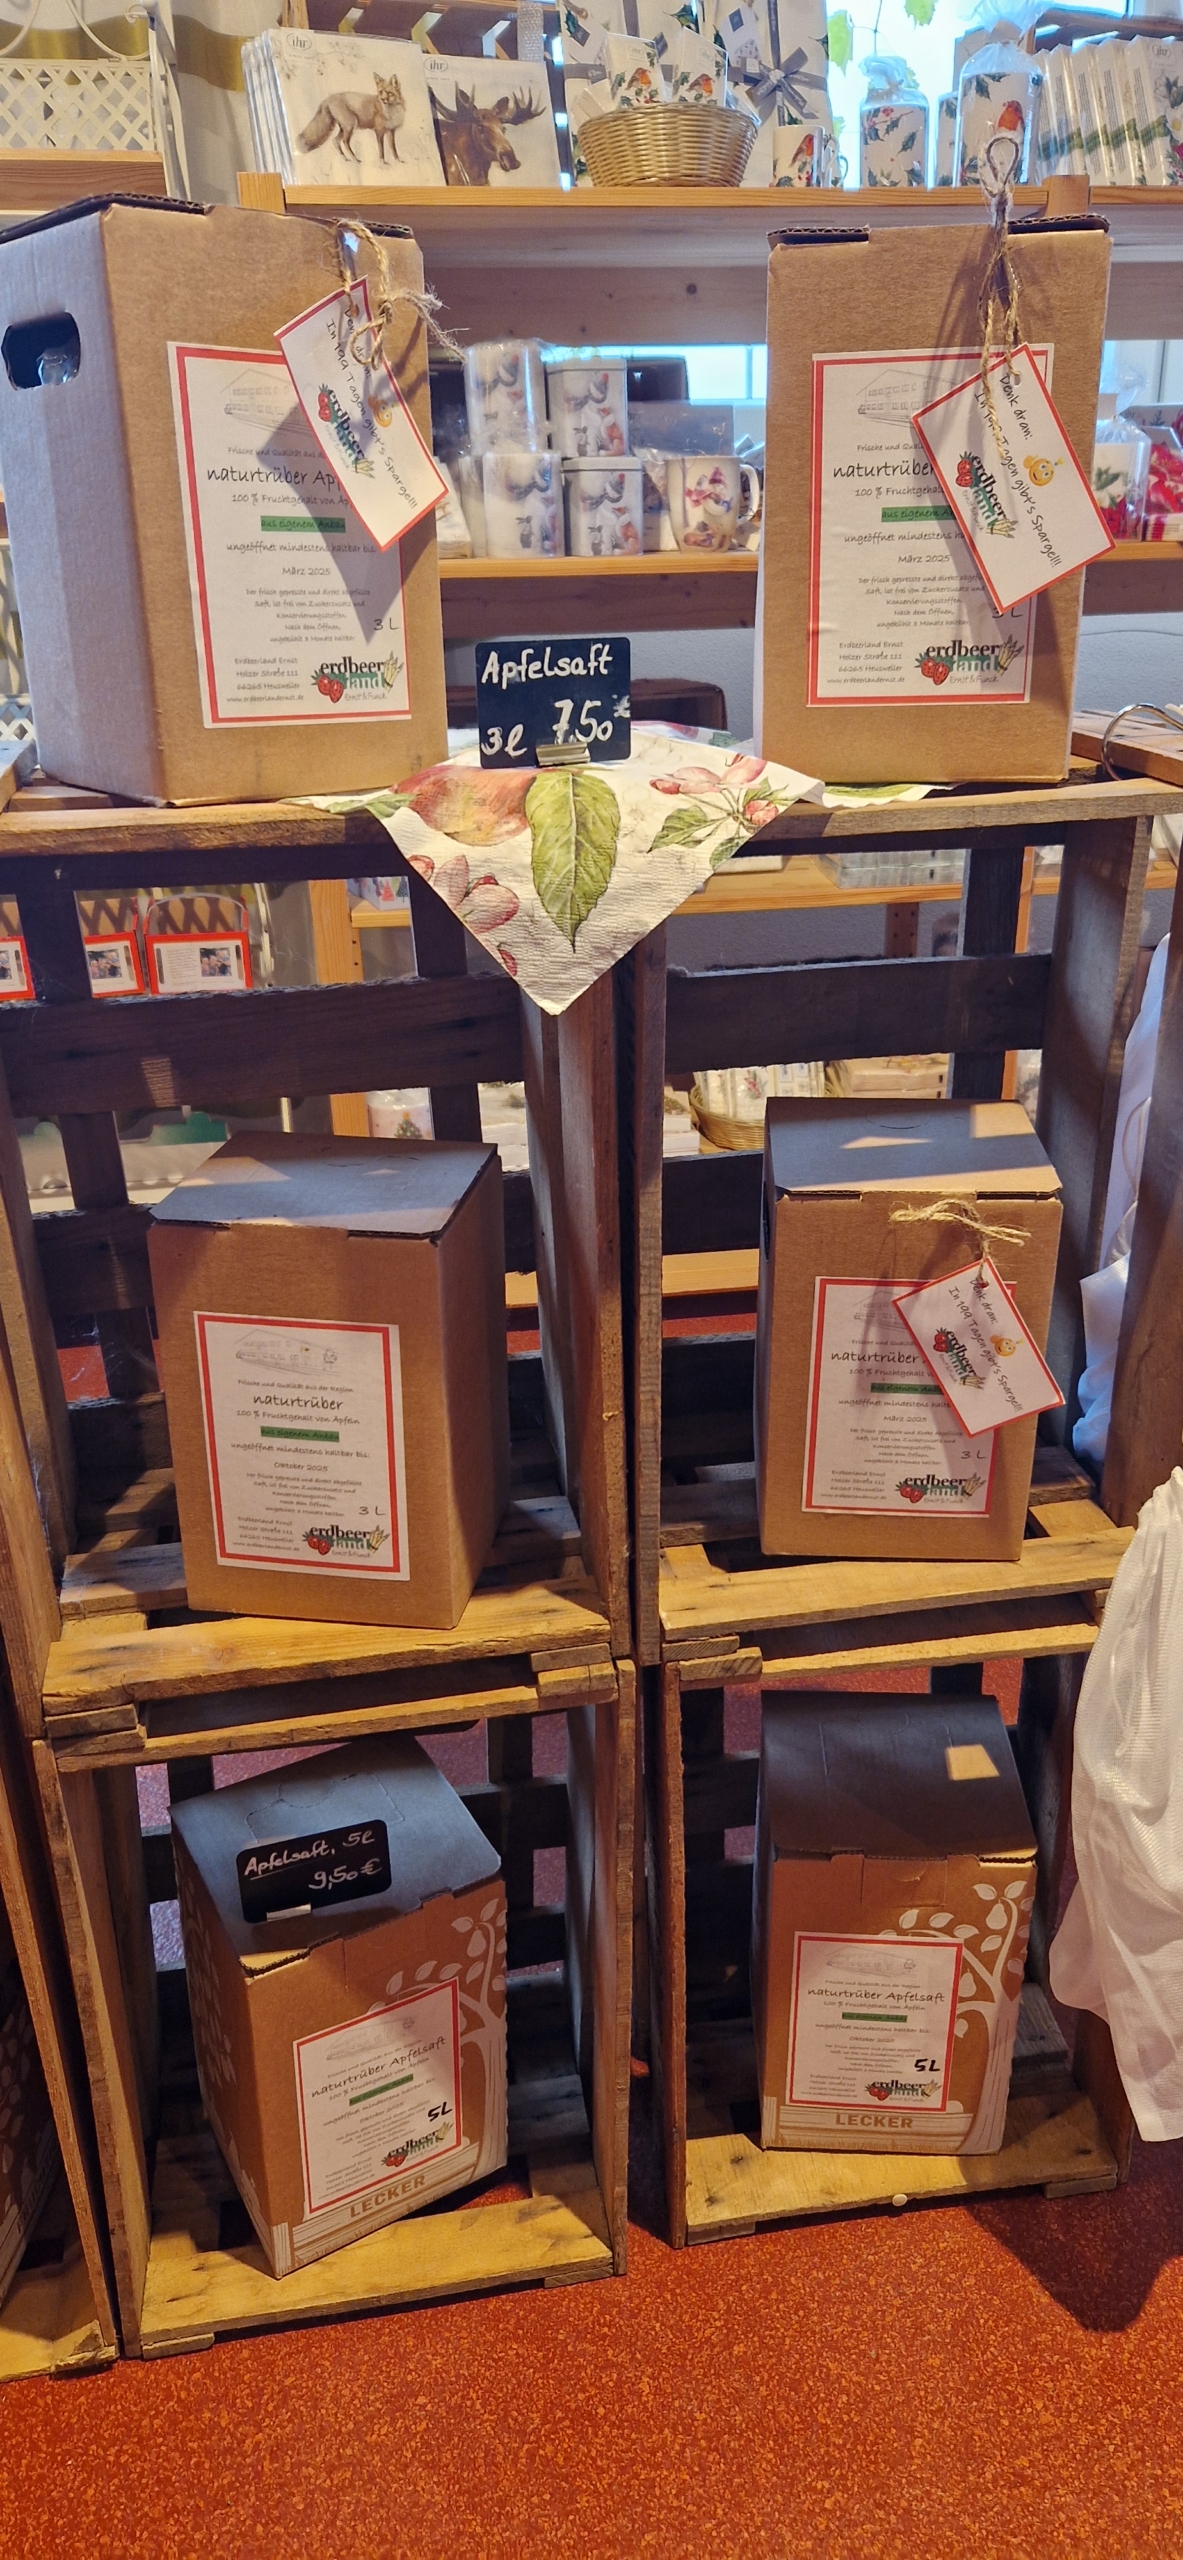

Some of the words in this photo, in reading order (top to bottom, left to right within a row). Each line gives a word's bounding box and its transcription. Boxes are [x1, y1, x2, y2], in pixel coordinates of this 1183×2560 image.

[291, 35, 309, 49] ihr
[429, 60, 445, 71] ihr
[326, 318, 337, 340] In
[999, 373, 1019, 407] Denk
[1013, 409, 1033, 440] dran:
[328, 389, 365, 459] erdbeer
[857, 443, 883, 451] Frische
[974, 388, 988, 409] In
[1011, 479, 1036, 515] gibt's
[207, 465, 308, 484] naturtrüber
[855, 489, 873, 497] 100
[875, 486, 883, 499] %
[973, 455, 1007, 520] erdbeer
[231, 494, 249, 502] 100
[262, 494, 318, 506] Fruchtgehalt
[882, 510, 898, 519] aus
[901, 509, 939, 520] eigenem
[278, 519, 315, 531] eigenem
[844, 532, 896, 545] ungeöffnet
[898, 531, 952, 541] mindestens
[226, 541, 277, 554] ungeöffnet
[279, 542, 329, 552] mindestens
[898, 555, 923, 563] März
[926, 554, 951, 563] 2025
[282, 567, 306, 575] März
[308, 567, 331, 576] 2025
[1011, 607, 1023, 618] L
[373, 619, 384, 631] 3
[389, 617, 399, 630] L
[926, 640, 1000, 658] erdbeer
[320, 656, 384, 675] erdbeer
[481, 643, 613, 690] Apfelsaft
[950, 656, 998, 672] land
[345, 674, 384, 689] land
[969, 1278, 985, 1302] Denk
[981, 1301, 998, 1325] dran:
[948, 1286, 960, 1300] In
[957, 1300, 972, 1319] 199
[968, 1319, 987, 1350] Tagen
[980, 1349, 1002, 1375] gibt's
[831, 1351, 920, 1364] naturtrüber
[946, 1331, 976, 1377] erdbeer
[875, 1368, 925, 1380] Fruchtgehalt
[253, 1394, 344, 1410] naturtrüber
[838, 1398, 882, 1410] ungeöffnet
[884, 1399, 929, 1408] mindestens
[236, 1410, 251, 1418] 100
[262, 1411, 313, 1423] Fruchtgehalt
[231, 1442, 274, 1454] ungeöffnet
[277, 1445, 323, 1455] mindestens
[325, 1449, 354, 1458] haltbar
[961, 1451, 970, 1459] 3
[977, 1450, 986, 1459] L
[274, 1462, 305, 1470] Oktober
[307, 1464, 328, 1472] 2025
[904, 1474, 965, 1486] erdbeer
[926, 1486, 964, 1497] land
[359, 1506, 369, 1515] 3
[375, 1506, 386, 1516] L
[309, 1525, 370, 1540] erdbeer
[333, 1538, 370, 1550] land
[807, 1987, 882, 2000] naturtrüber
[885, 1991, 946, 2003] Apfelsaft
[311, 2063, 387, 2098] naturtrüber
[389, 2036, 446, 2068] Apfelsaft
[871, 2080, 926, 2090] erdbeer
[835, 2113, 914, 2129] LECKER
[387, 2131, 439, 2158] erdbeer
[350, 2175, 426, 2218] LECKER
